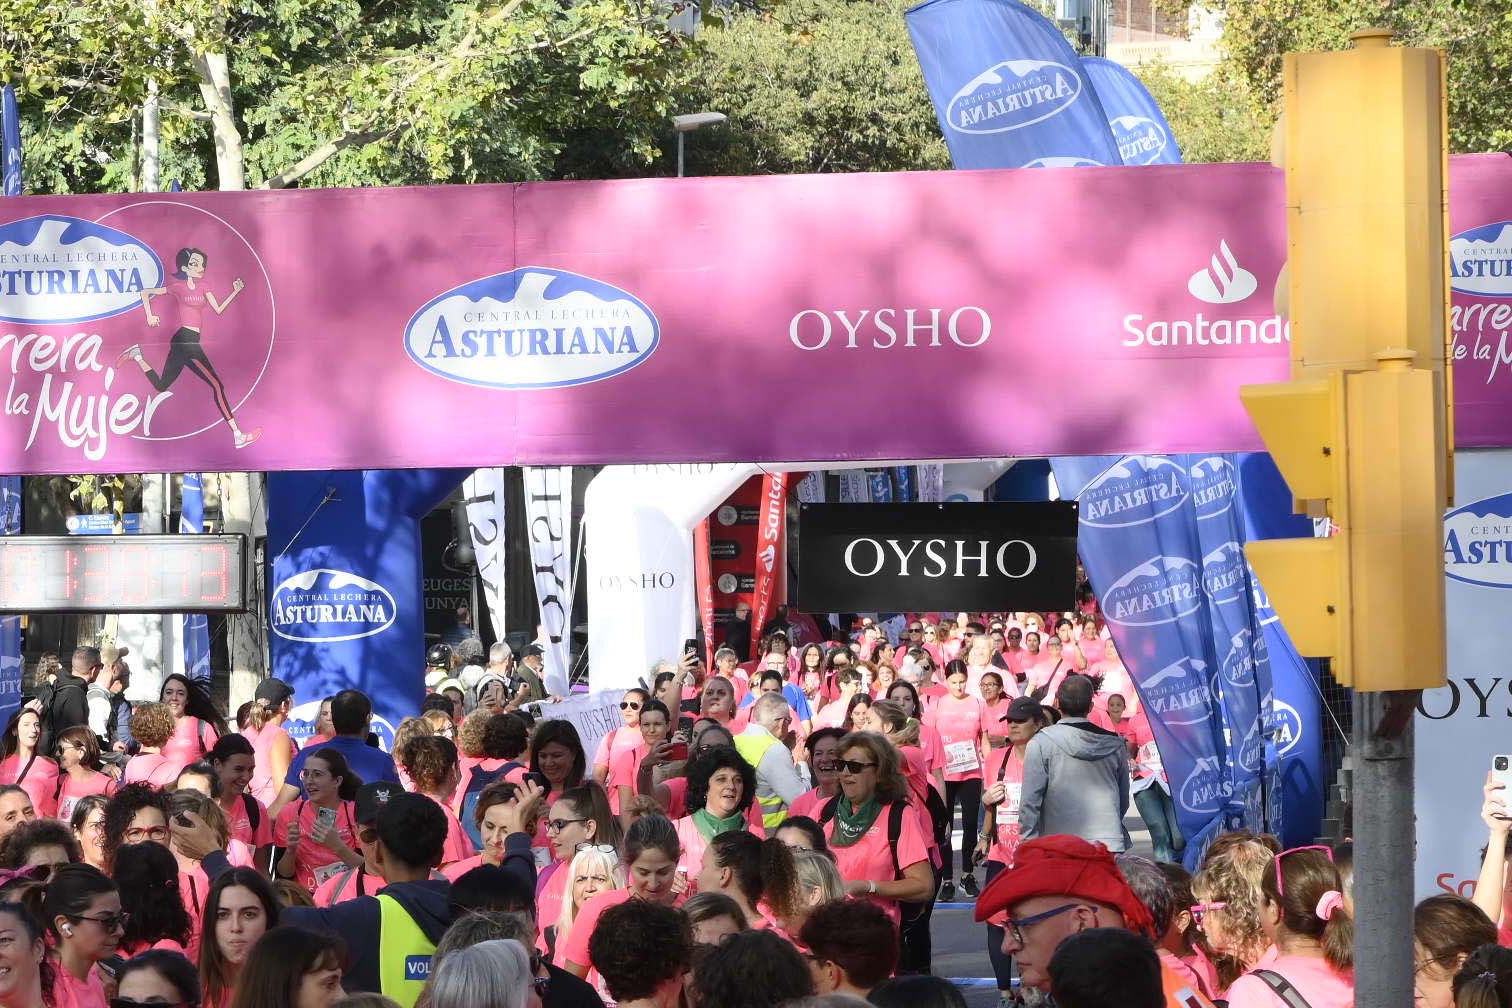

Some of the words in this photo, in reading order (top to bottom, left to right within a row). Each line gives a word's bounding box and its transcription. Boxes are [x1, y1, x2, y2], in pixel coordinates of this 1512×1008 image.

[67, 251, 138, 263] LECHERA
[464, 310, 541, 323] CENTRAL
[551, 307, 632, 320] LECHERA
[789, 305, 992, 351] OYSHO
[424, 314, 641, 359] ASTURIANA
[1473, 332, 1491, 360] la
[5, 374, 30, 415] la
[24, 367, 174, 462] Mujer
[844, 538, 1037, 579] OYSHO
[287, 594, 329, 602] CENTRAL
[334, 593, 382, 602] LECHERA
[274, 599, 388, 626] ASTURIANA
